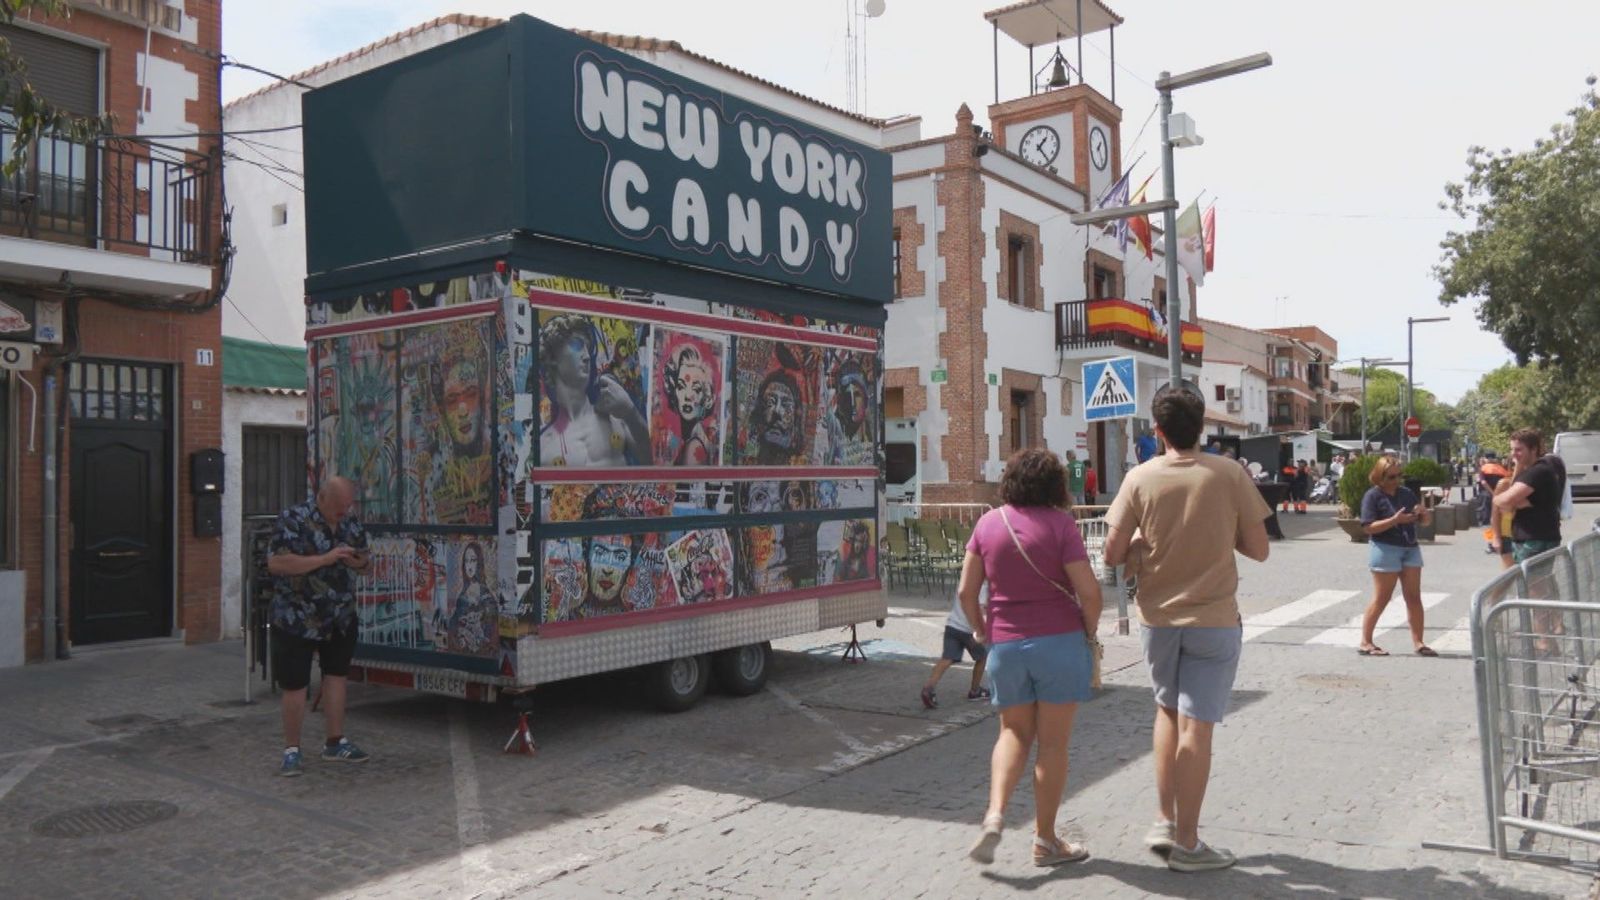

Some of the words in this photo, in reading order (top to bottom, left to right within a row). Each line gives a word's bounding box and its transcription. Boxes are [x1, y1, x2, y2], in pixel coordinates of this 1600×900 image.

[582, 62, 719, 169] NEW
[740, 121, 862, 210] YORK
[609, 160, 853, 276] CANDY
[0, 346, 20, 364] O
[199, 352, 212, 364] 11
